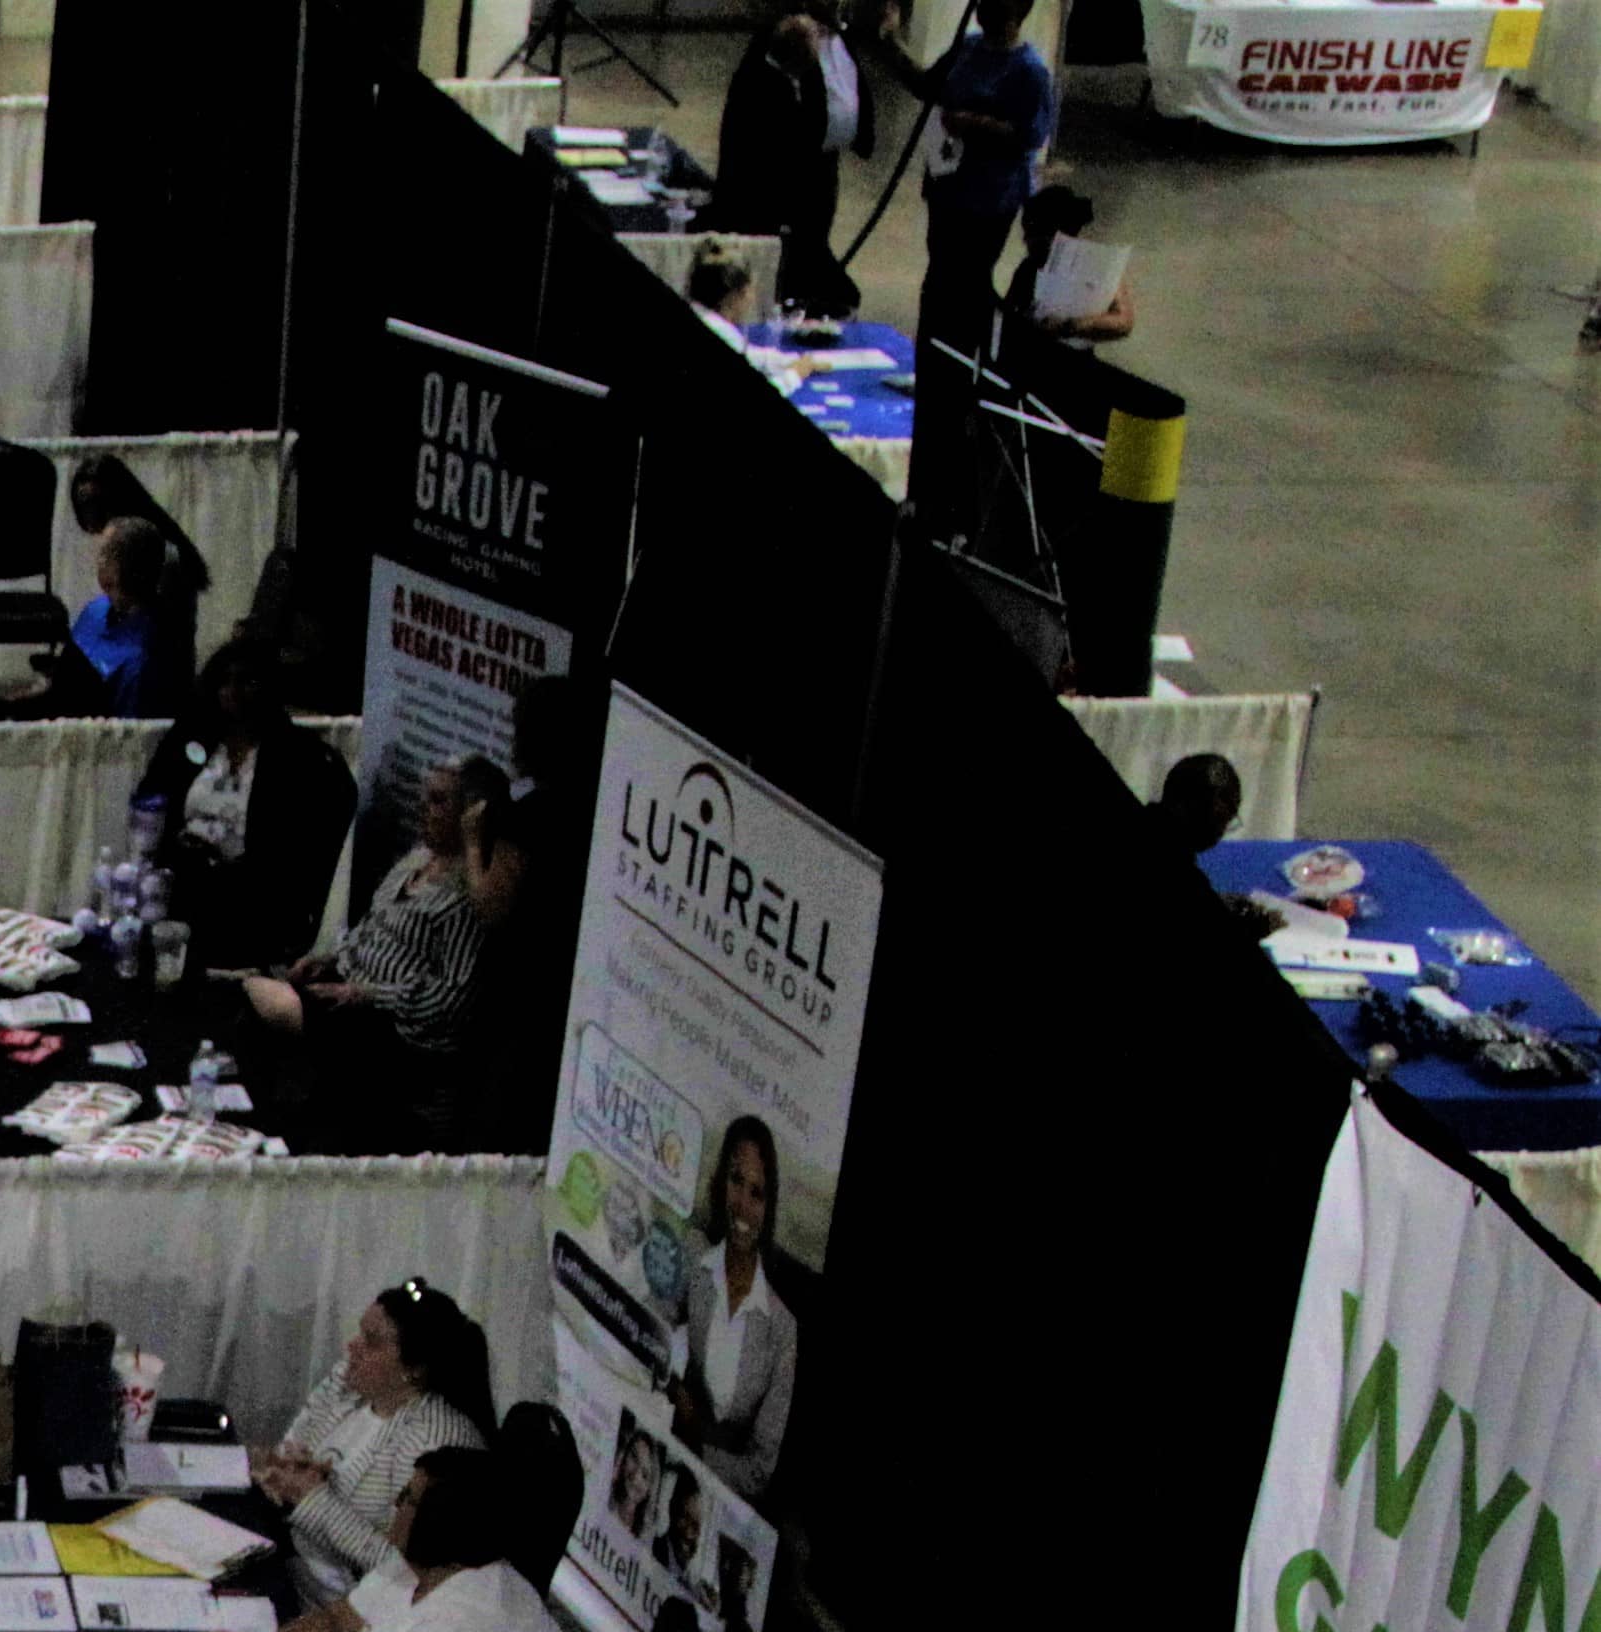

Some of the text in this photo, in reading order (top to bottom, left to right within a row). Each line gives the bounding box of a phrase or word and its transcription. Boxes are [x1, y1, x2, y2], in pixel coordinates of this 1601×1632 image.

[1199, 25, 1230, 48] 78
[1240, 39, 1374, 71] FINISH
[1384, 38, 1472, 70] LINE
[1237, 73, 1463, 93] CAR WASH
[421, 371, 502, 459] OAK
[415, 443, 549, 550] GROVE
[391, 618, 523, 696] VEGAS ACTIO
[392, 583, 546, 671] A WHOLE LOTTA
[621, 781, 836, 992] LUTTRELL
[617, 850, 735, 956] STAFFING
[744, 946, 832, 1028] GROUP
